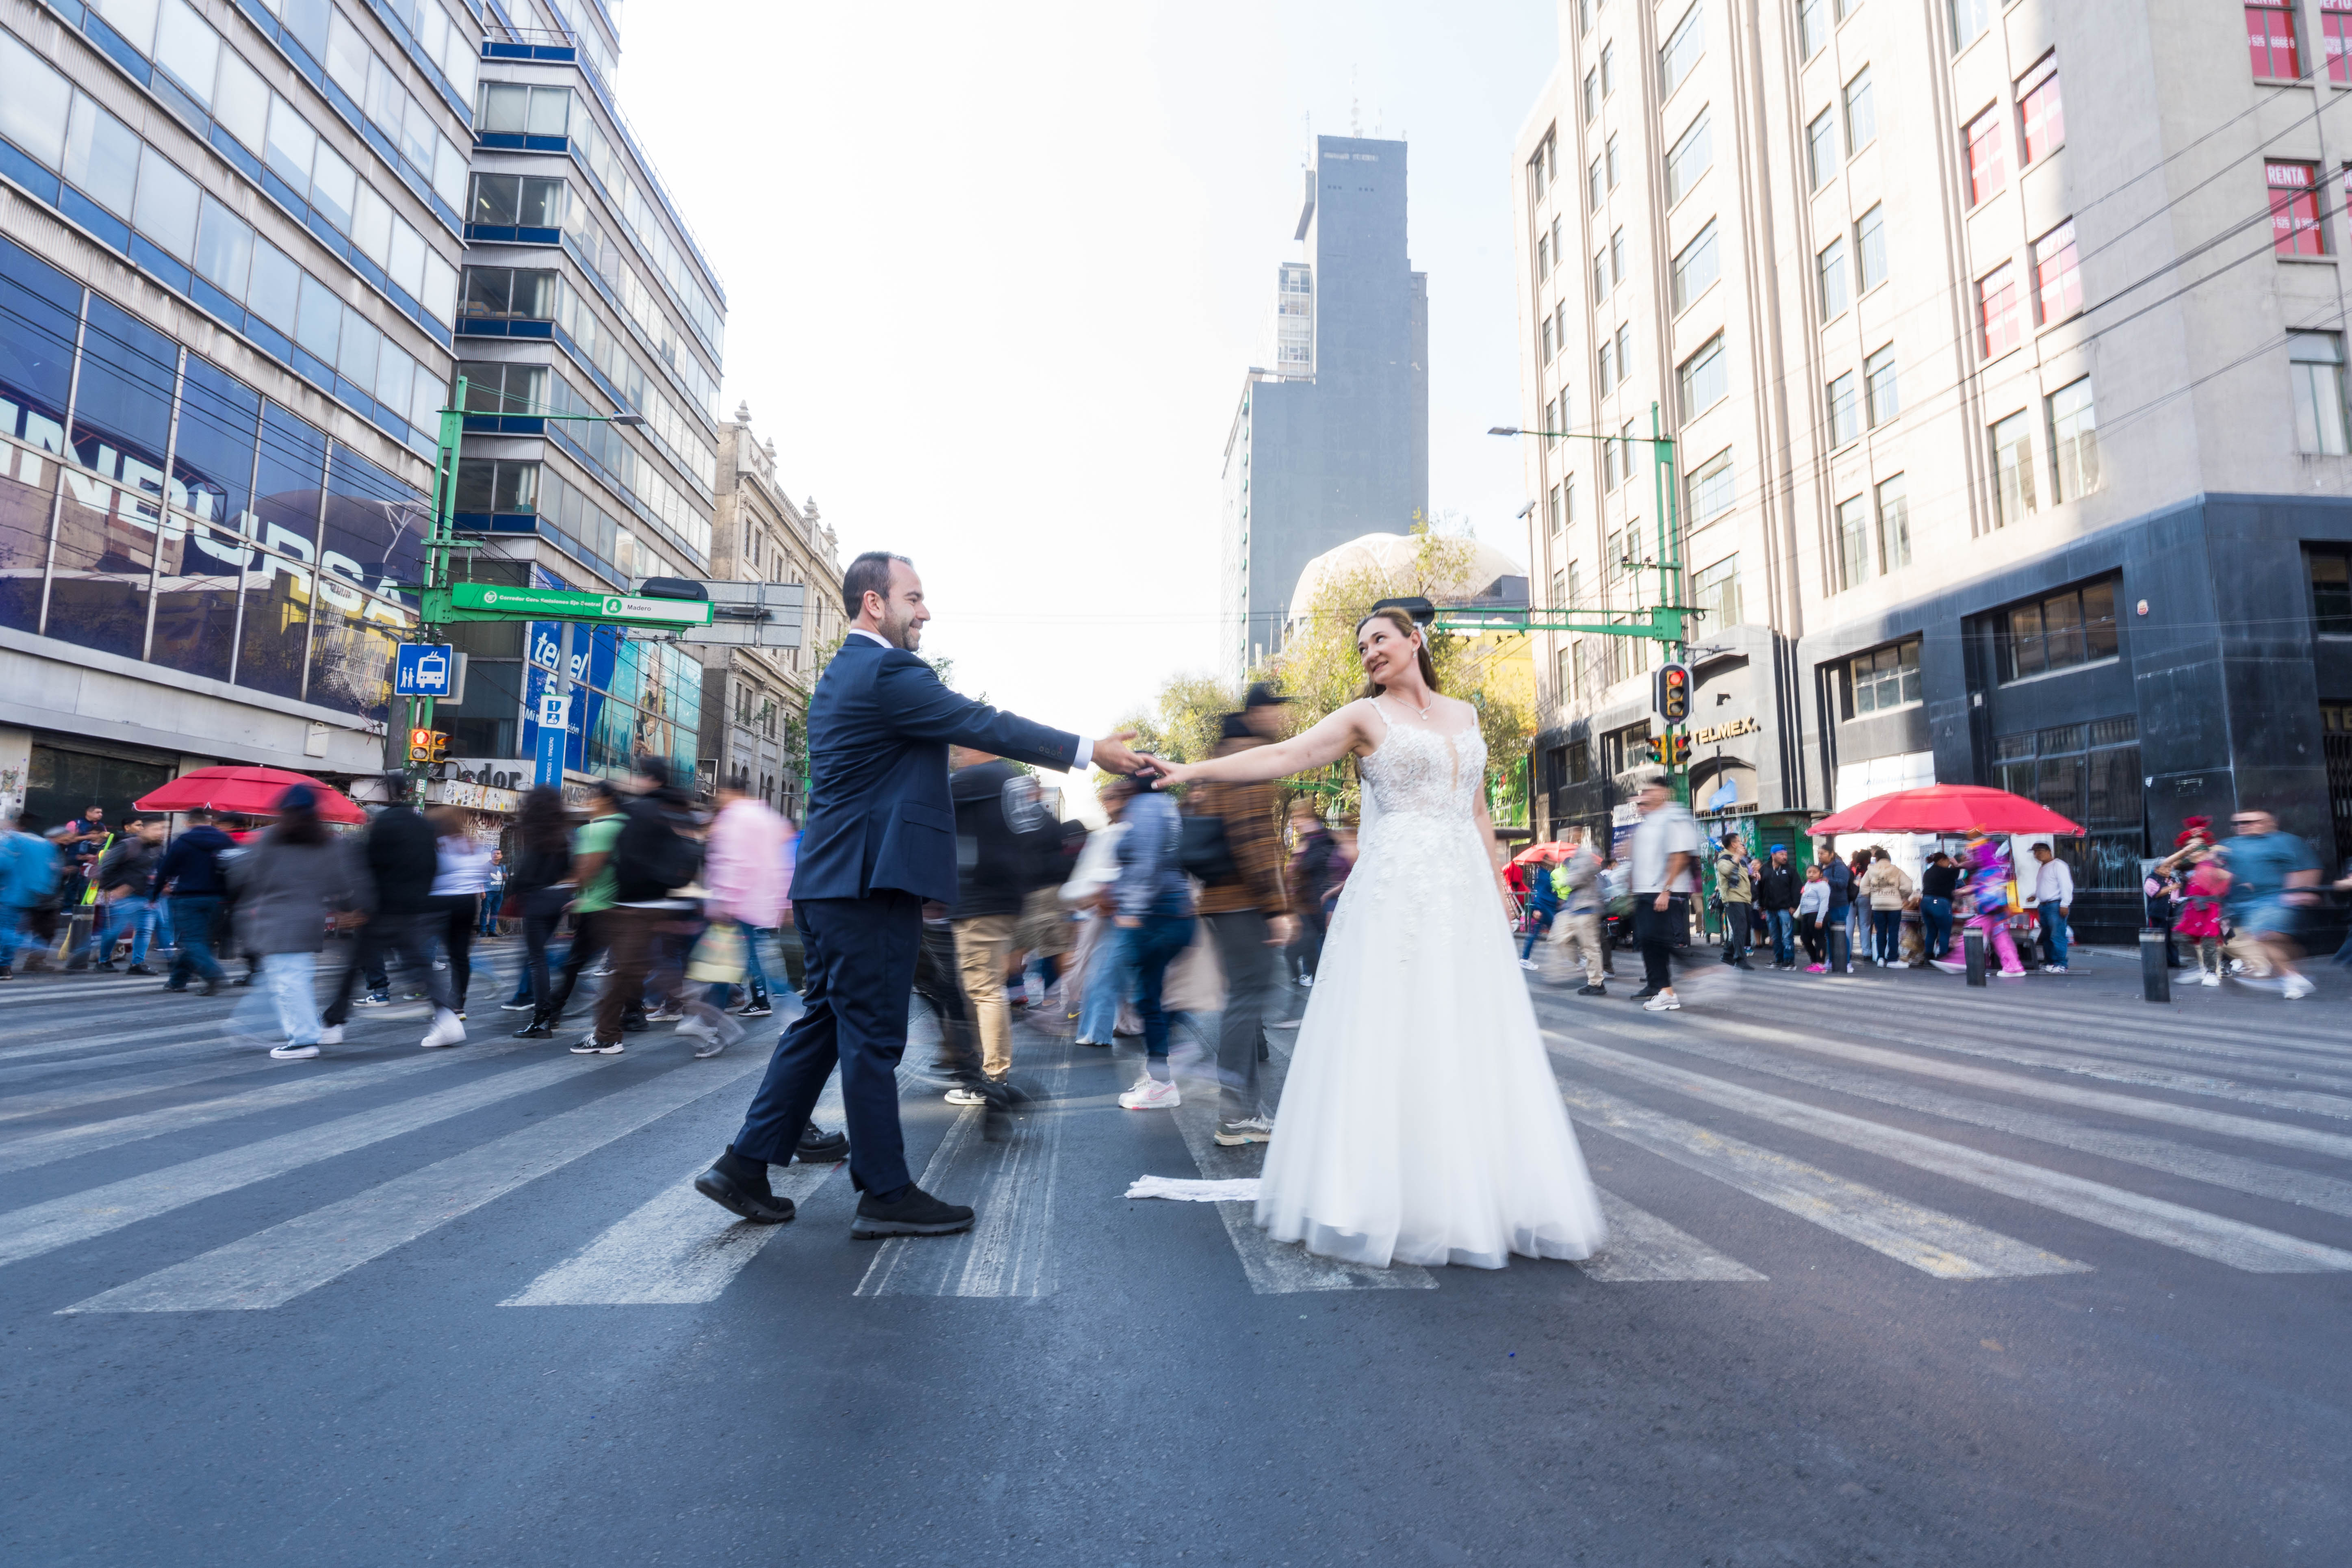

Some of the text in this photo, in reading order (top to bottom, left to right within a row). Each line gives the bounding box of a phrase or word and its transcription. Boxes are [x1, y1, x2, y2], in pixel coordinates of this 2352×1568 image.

[2267, 165, 2306, 185] RENTA
[2036, 220, 2075, 262] DEPTOS
[535, 632, 589, 680] telel
[552, 701, 556, 711] 1
[1690, 716, 1755, 745] TELMEX
